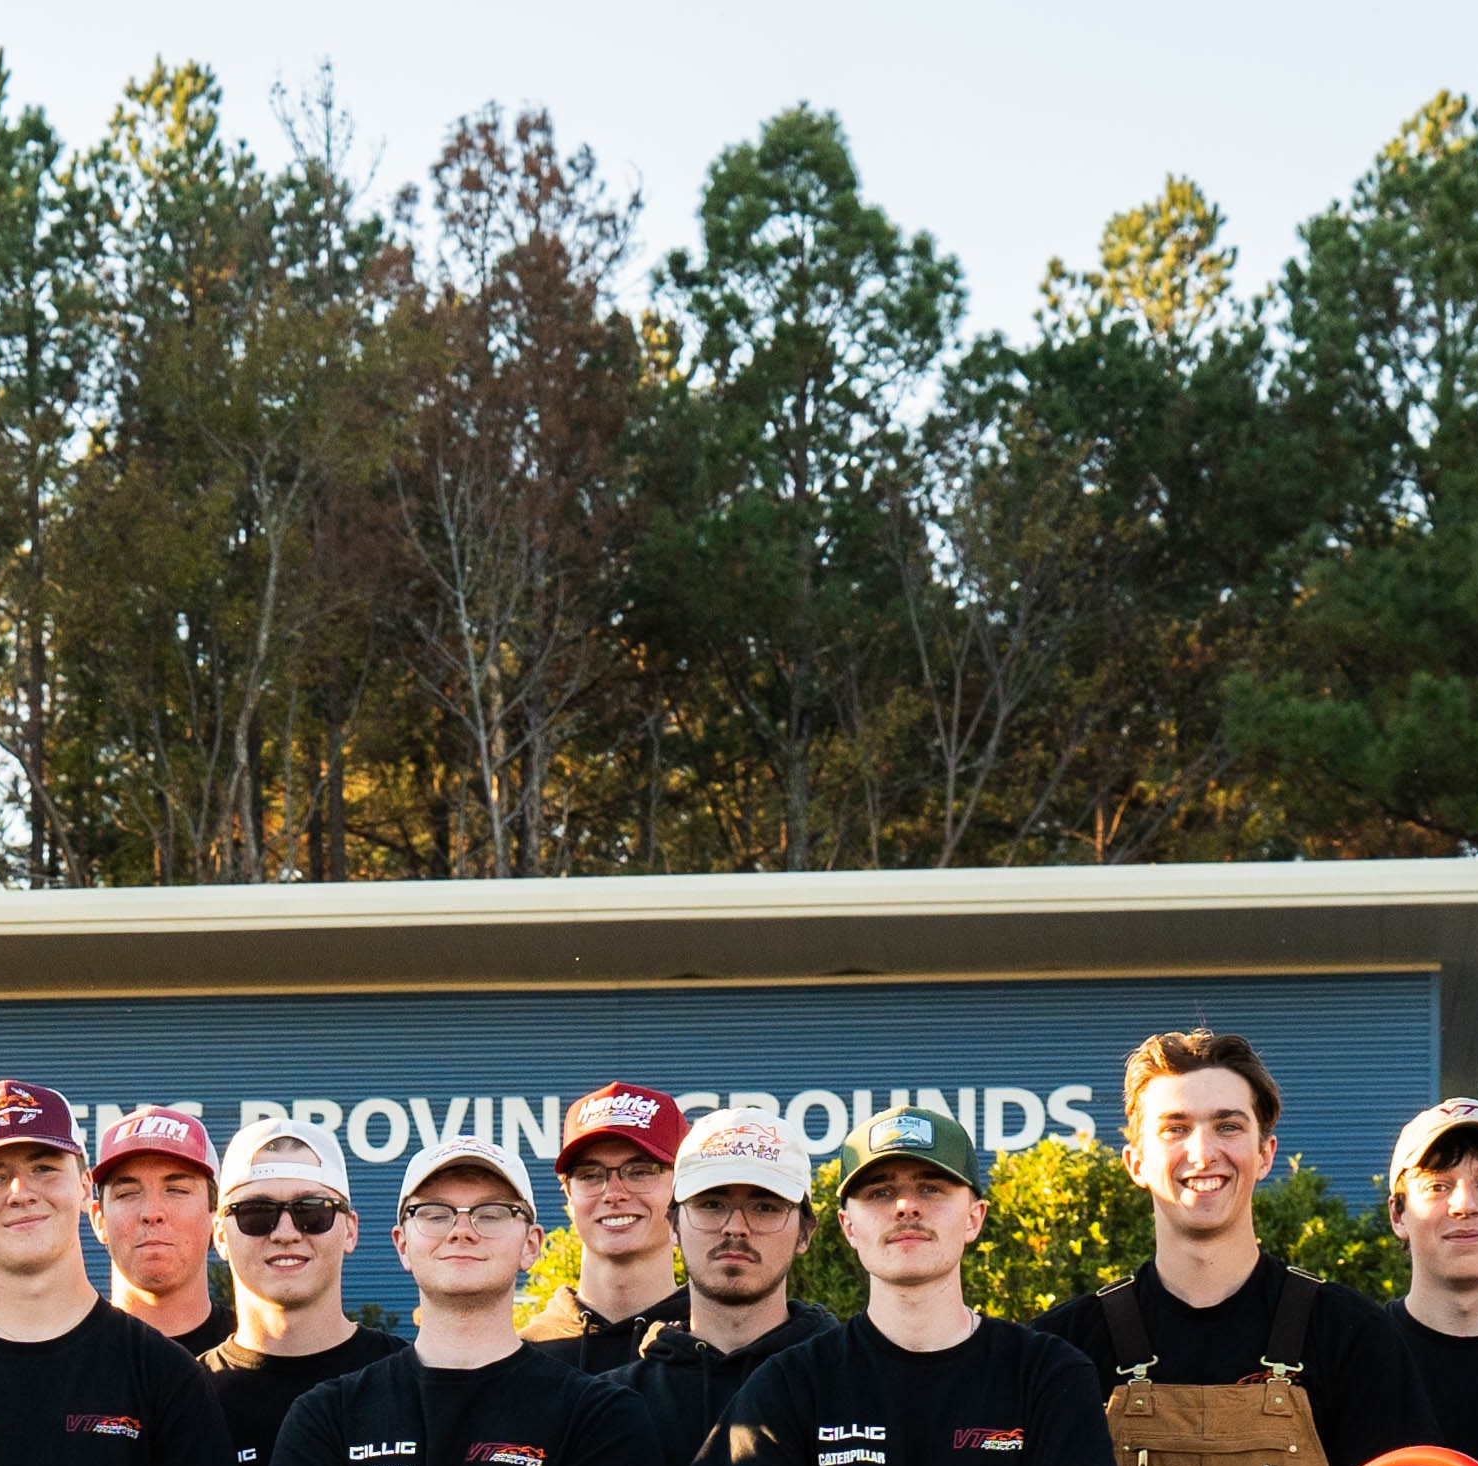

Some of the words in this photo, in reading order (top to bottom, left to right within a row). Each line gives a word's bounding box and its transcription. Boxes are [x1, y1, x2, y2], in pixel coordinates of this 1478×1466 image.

[818, 1423, 887, 1442] GILLIG
[348, 1441, 418, 1461] GILLIG
[818, 1448, 887, 1466] CATERPILLAR
